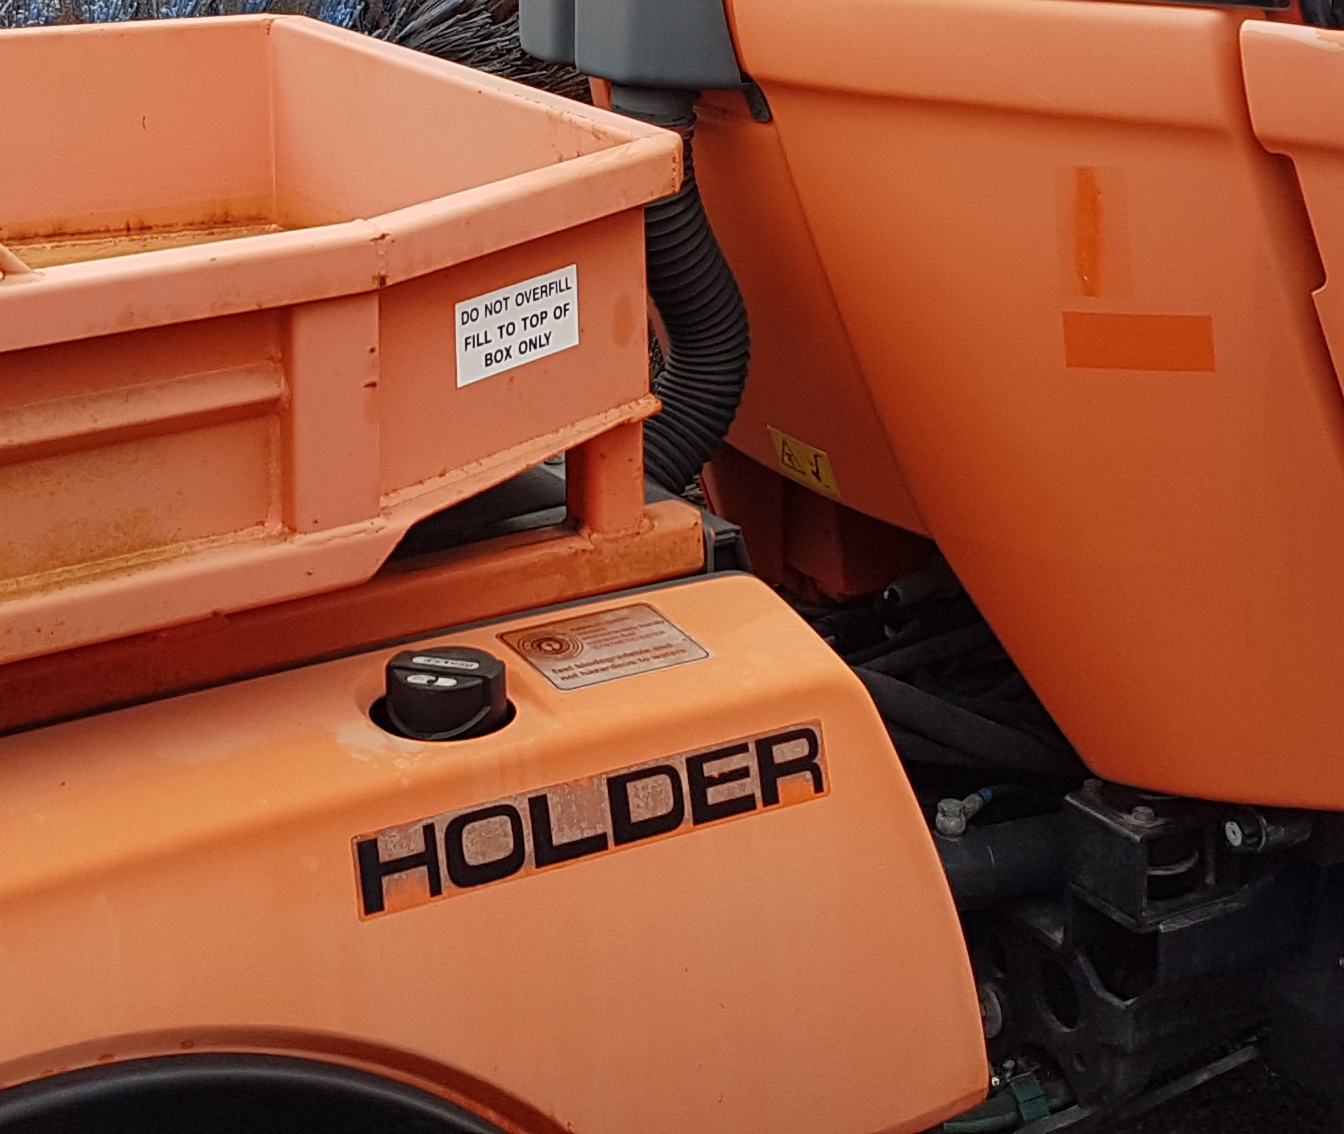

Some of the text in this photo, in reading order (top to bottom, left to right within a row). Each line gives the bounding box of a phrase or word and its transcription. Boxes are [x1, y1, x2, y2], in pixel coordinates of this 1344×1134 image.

[461, 277, 572, 325] DO NOT OVERFILL
[464, 302, 570, 351] FILL TO TOP OF
[485, 331, 552, 367] BOX ONLY
[356, 727, 825, 916] HOLDER
